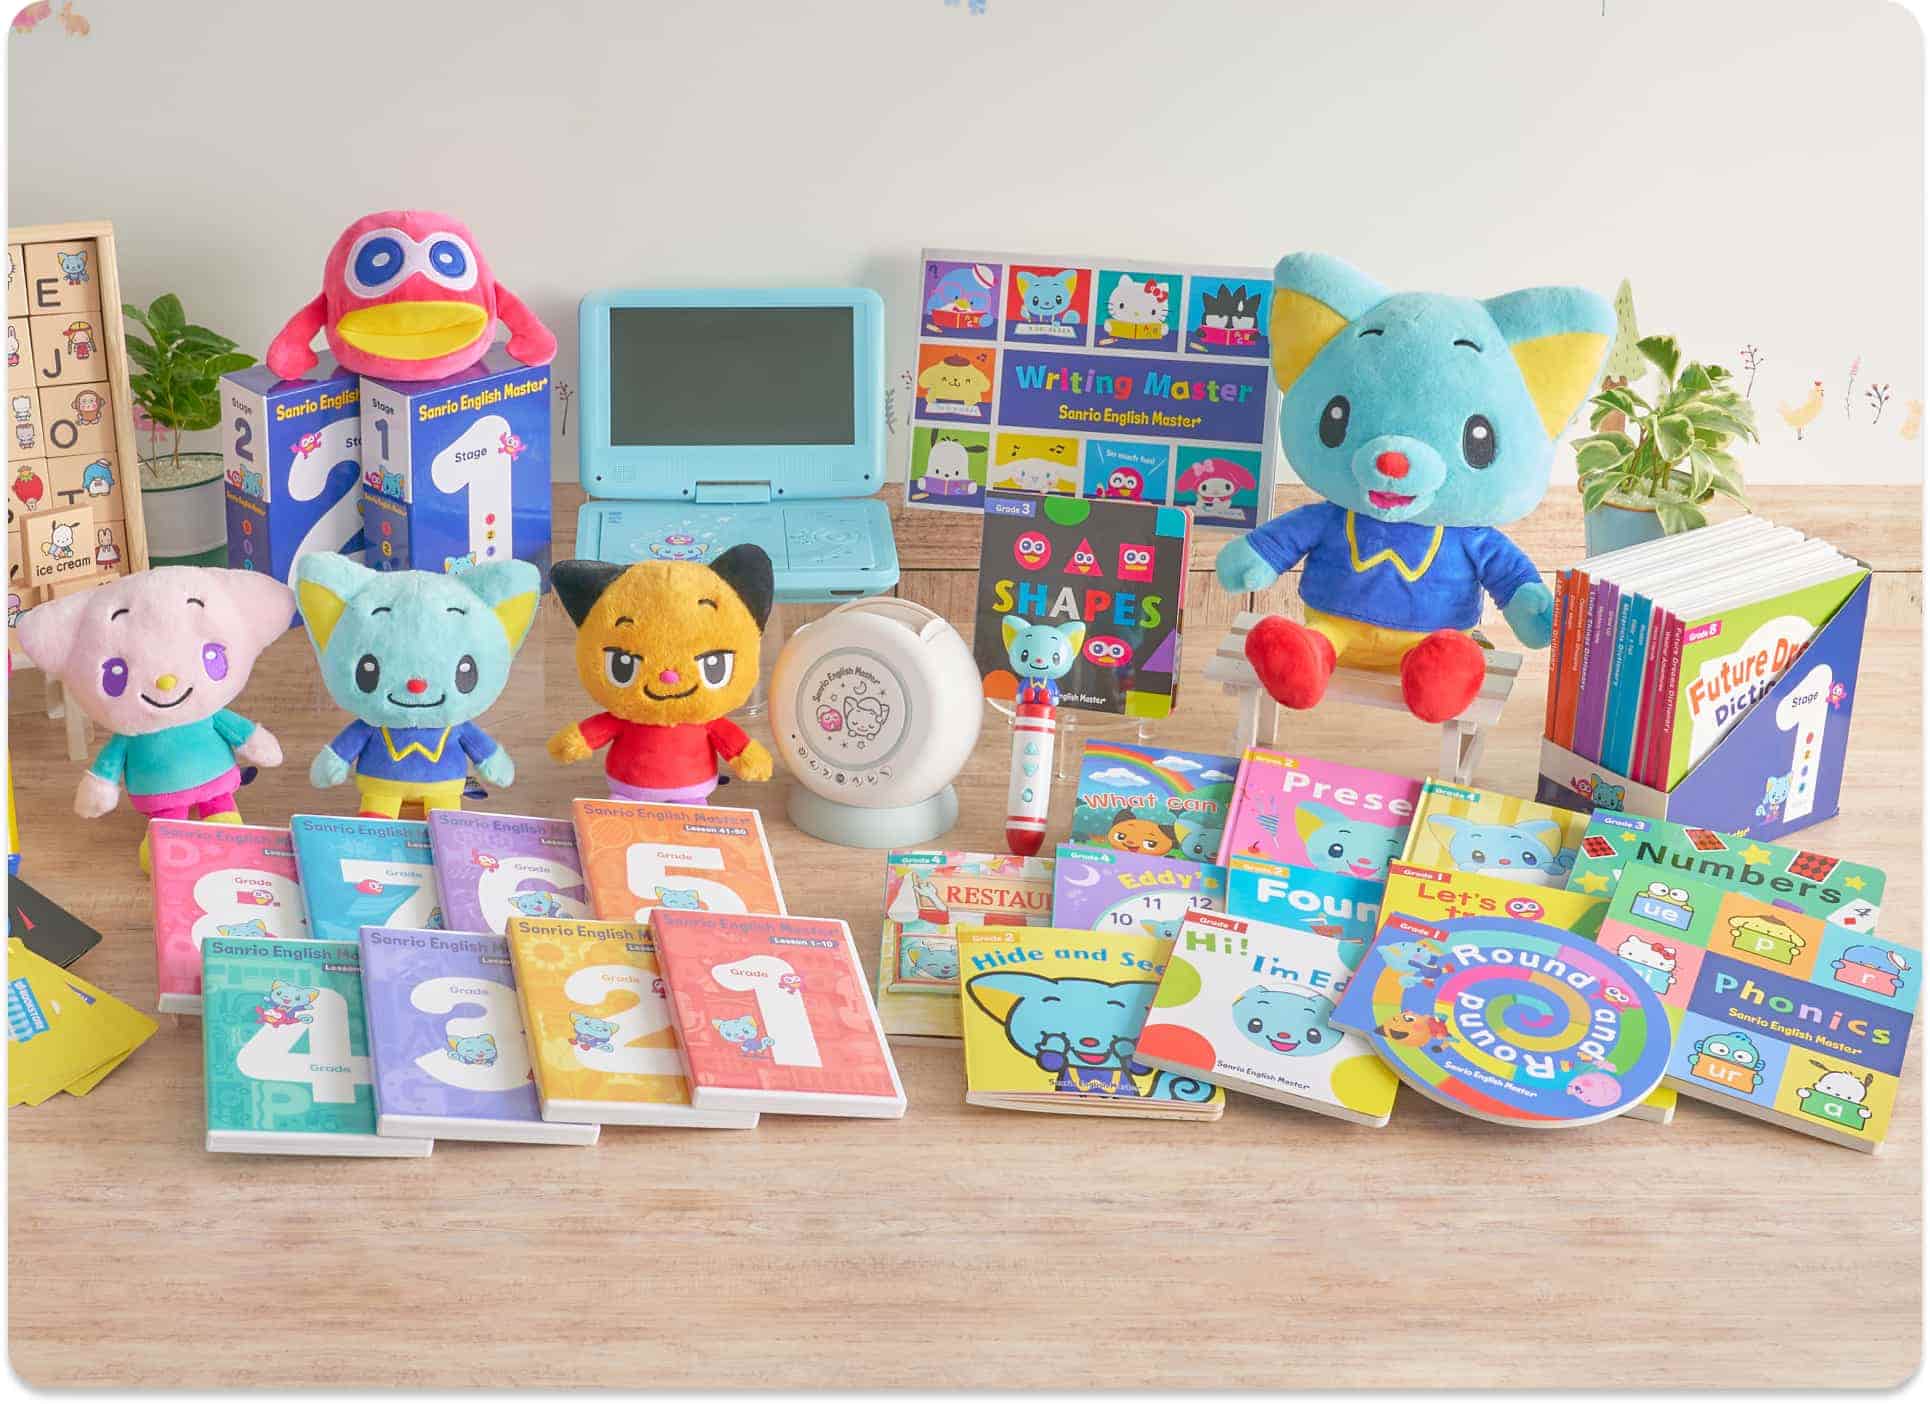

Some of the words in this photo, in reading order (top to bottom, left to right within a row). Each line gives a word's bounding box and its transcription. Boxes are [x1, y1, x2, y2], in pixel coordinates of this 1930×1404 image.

[36, 278, 61, 307] E
[43, 348, 62, 379] J
[1144, 371, 1253, 403] Master
[231, 397, 252, 414] Stage
[372, 397, 394, 415] Stage
[419, 401, 458, 422] Sanrio
[460, 389, 501, 412] English
[503, 378, 548, 399] Master
[275, 401, 318, 421] Sanrio
[1059, 404, 1101, 424] Sanrio
[1103, 407, 1149, 426] English
[50, 420, 78, 449] O
[233, 417, 253, 462] 2
[374, 418, 389, 461] 1
[454, 446, 488, 463] Stage
[996, 503, 1020, 514] Grade
[1021, 503, 1031, 514] 3
[36, 565, 53, 577] ice
[56, 557, 91, 573] cream
[992, 579, 1163, 629] SHAPES
[1688, 629, 1709, 643] Grade
[1689, 650, 1768, 716] Future
[1791, 691, 1819, 708] Stage
[1776, 664, 1832, 823] 1
[1084, 793, 1156, 810] What
[1168, 797, 1217, 813] can
[1283, 771, 1413, 817] Prese
[584, 804, 634, 818] Sanrio
[637, 809, 691, 824] English
[1604, 817, 1633, 829] Grade
[1635, 820, 1645, 830] 3
[303, 820, 354, 834] Sanrio
[357, 824, 411, 840] English
[439, 814, 489, 830] Sanrio
[493, 820, 546, 836] English
[656, 851, 693, 862] Grade
[931, 854, 941, 865] 4
[384, 868, 423, 879] Grade
[514, 863, 551, 874] Grade
[1404, 869, 1433, 880] Grade
[1636, 840, 1844, 904] Numbers
[234, 876, 272, 887] Grade
[1117, 870, 1220, 891] Eddy's
[1143, 896, 1162, 911] 11
[1190, 896, 1213, 911] 12
[1418, 883, 1497, 911] Let's
[1111, 912, 1133, 926] 10
[1643, 900, 1680, 923] ue
[519, 921, 573, 938] Sanrio
[577, 924, 634, 942] English
[1199, 918, 1229, 929] Grade
[1233, 921, 1239, 930] 1
[1400, 923, 1429, 937] Grade
[371, 932, 427, 949] Sanrio
[430, 938, 490, 954] English
[774, 937, 808, 947] Lesson
[1004, 931, 1015, 943] 2
[1185, 931, 1249, 956] Hi!
[1754, 936, 1774, 952] p
[212, 941, 269, 957] Sanrio
[272, 944, 332, 961] English
[971, 947, 1043, 971] Hide
[1054, 948, 1107, 961] and
[730, 968, 769, 979] Grade
[1252, 954, 1298, 981] I'm
[1451, 943, 1597, 988] Round
[600, 973, 641, 984] Grade
[1861, 972, 1876, 984] r
[449, 985, 489, 996] Grade
[711, 955, 823, 1068] 1
[1714, 972, 1892, 1046] Phonics
[564, 965, 686, 1076] 2
[410, 977, 535, 1092] 3
[1455, 992, 1556, 1079] Round
[1579, 1008, 1617, 1062] and
[1728, 1007, 1768, 1028] Sanrio
[1769, 1020, 1813, 1042] English
[1815, 1033, 1862, 1055] Master
[236, 986, 372, 1103] 4
[310, 1063, 352, 1074] Grade
[1217, 1059, 1244, 1074] Sanrio
[1246, 1067, 1276, 1082] English
[1277, 1075, 1310, 1090] Master
[1444, 1060, 1471, 1077] Sanrio
[1473, 1070, 1503, 1088] English
[1707, 1063, 1743, 1083] ur
[1824, 1101, 1843, 1118] a
